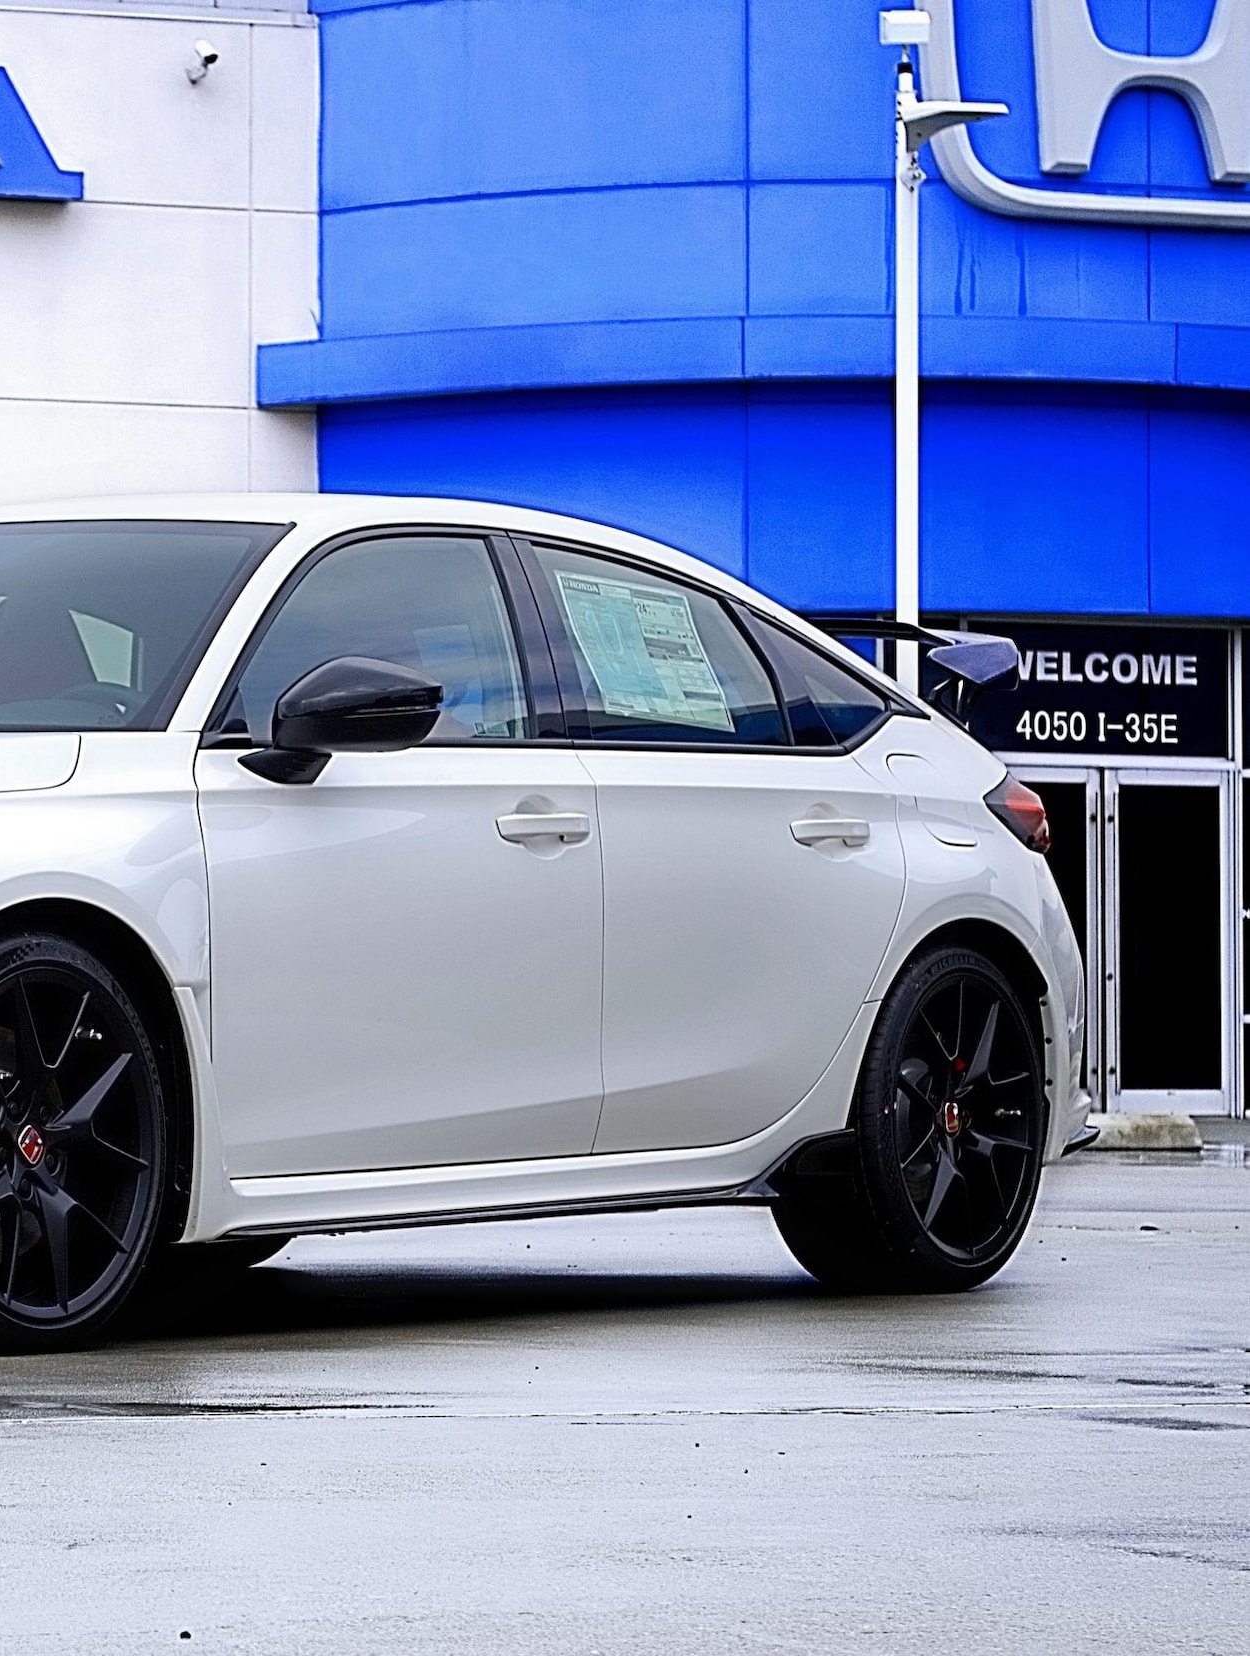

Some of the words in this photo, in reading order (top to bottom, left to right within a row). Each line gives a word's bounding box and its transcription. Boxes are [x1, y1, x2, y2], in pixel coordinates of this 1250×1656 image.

[569, 580, 600, 593] HONDA
[1016, 710, 1087, 742] 4050
[1098, 712, 1179, 744] I-35E
